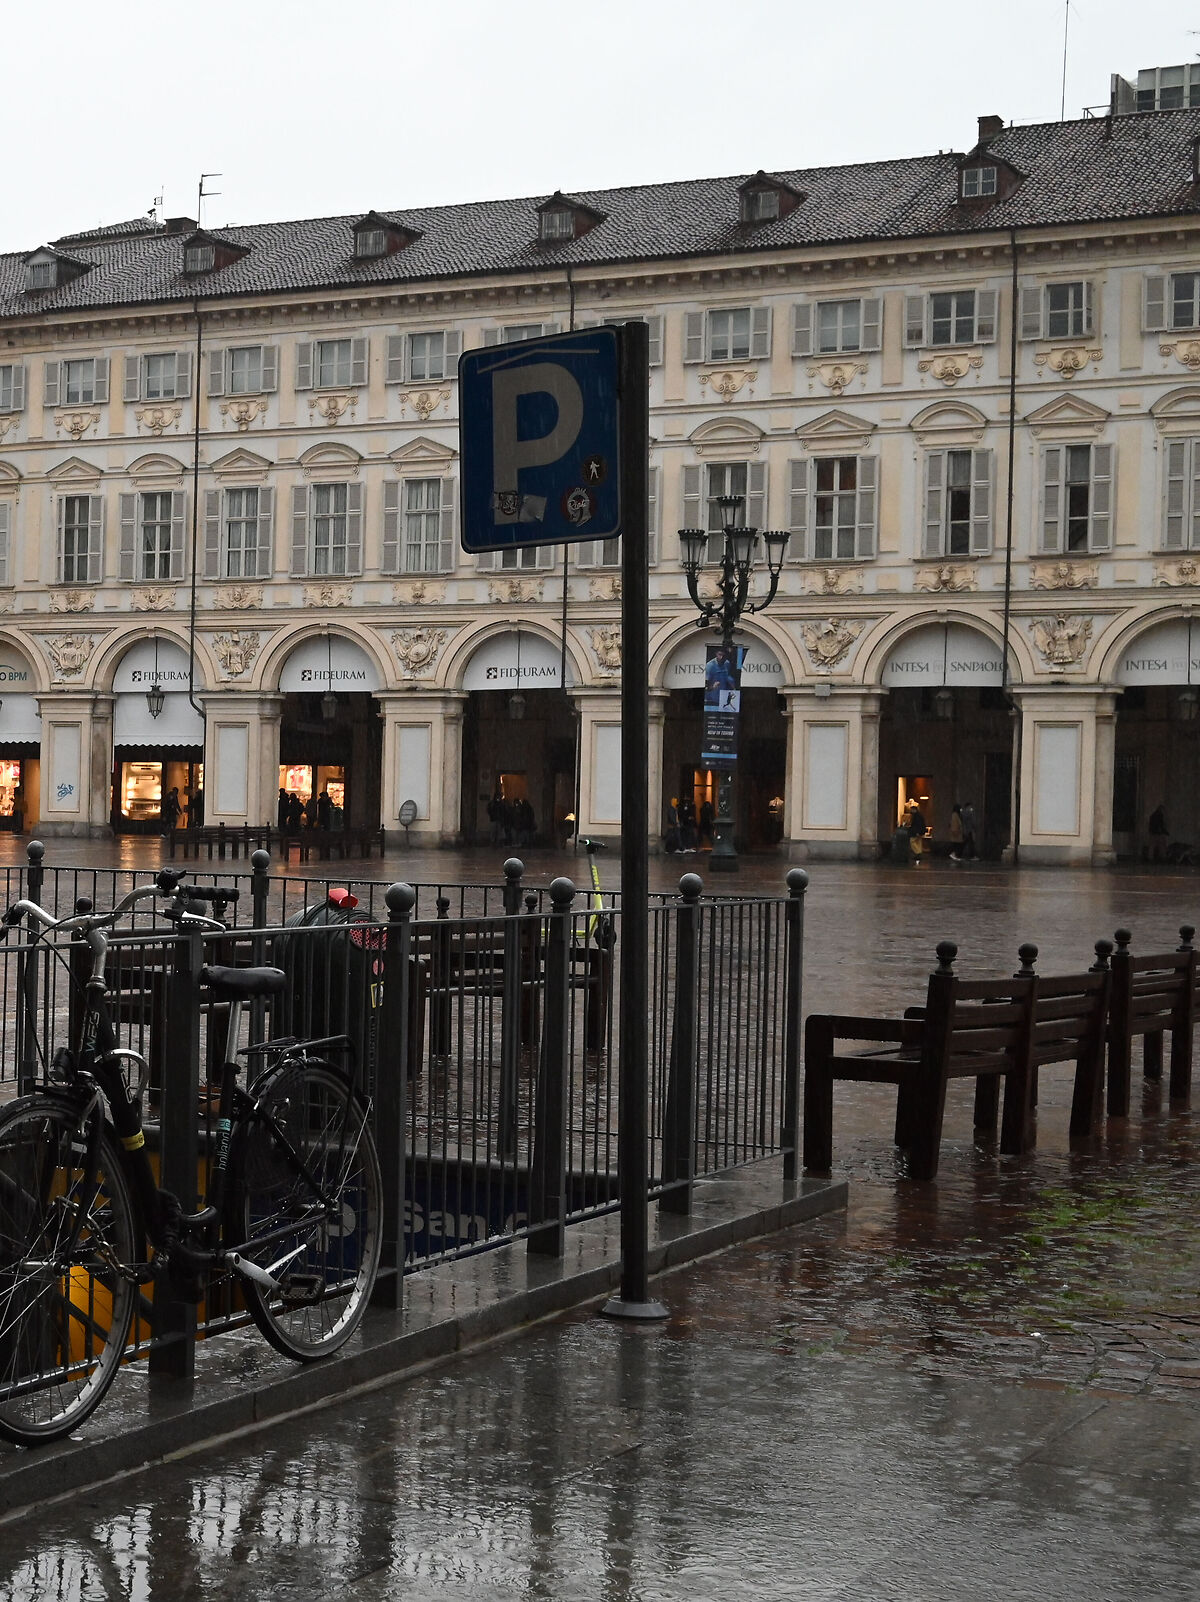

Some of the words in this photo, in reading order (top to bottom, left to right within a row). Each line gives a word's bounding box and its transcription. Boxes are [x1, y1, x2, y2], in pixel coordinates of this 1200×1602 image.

[492, 362, 584, 525] P
[675, 664, 706, 674] INTES
[891, 662, 929, 673] INTESA
[1125, 660, 1168, 671] INTESA
[8, 671, 28, 681] BPM
[143, 671, 191, 681] FIDEURAM
[313, 670, 366, 680] FIDEURAM
[500, 667, 556, 678] FIDEURAM
